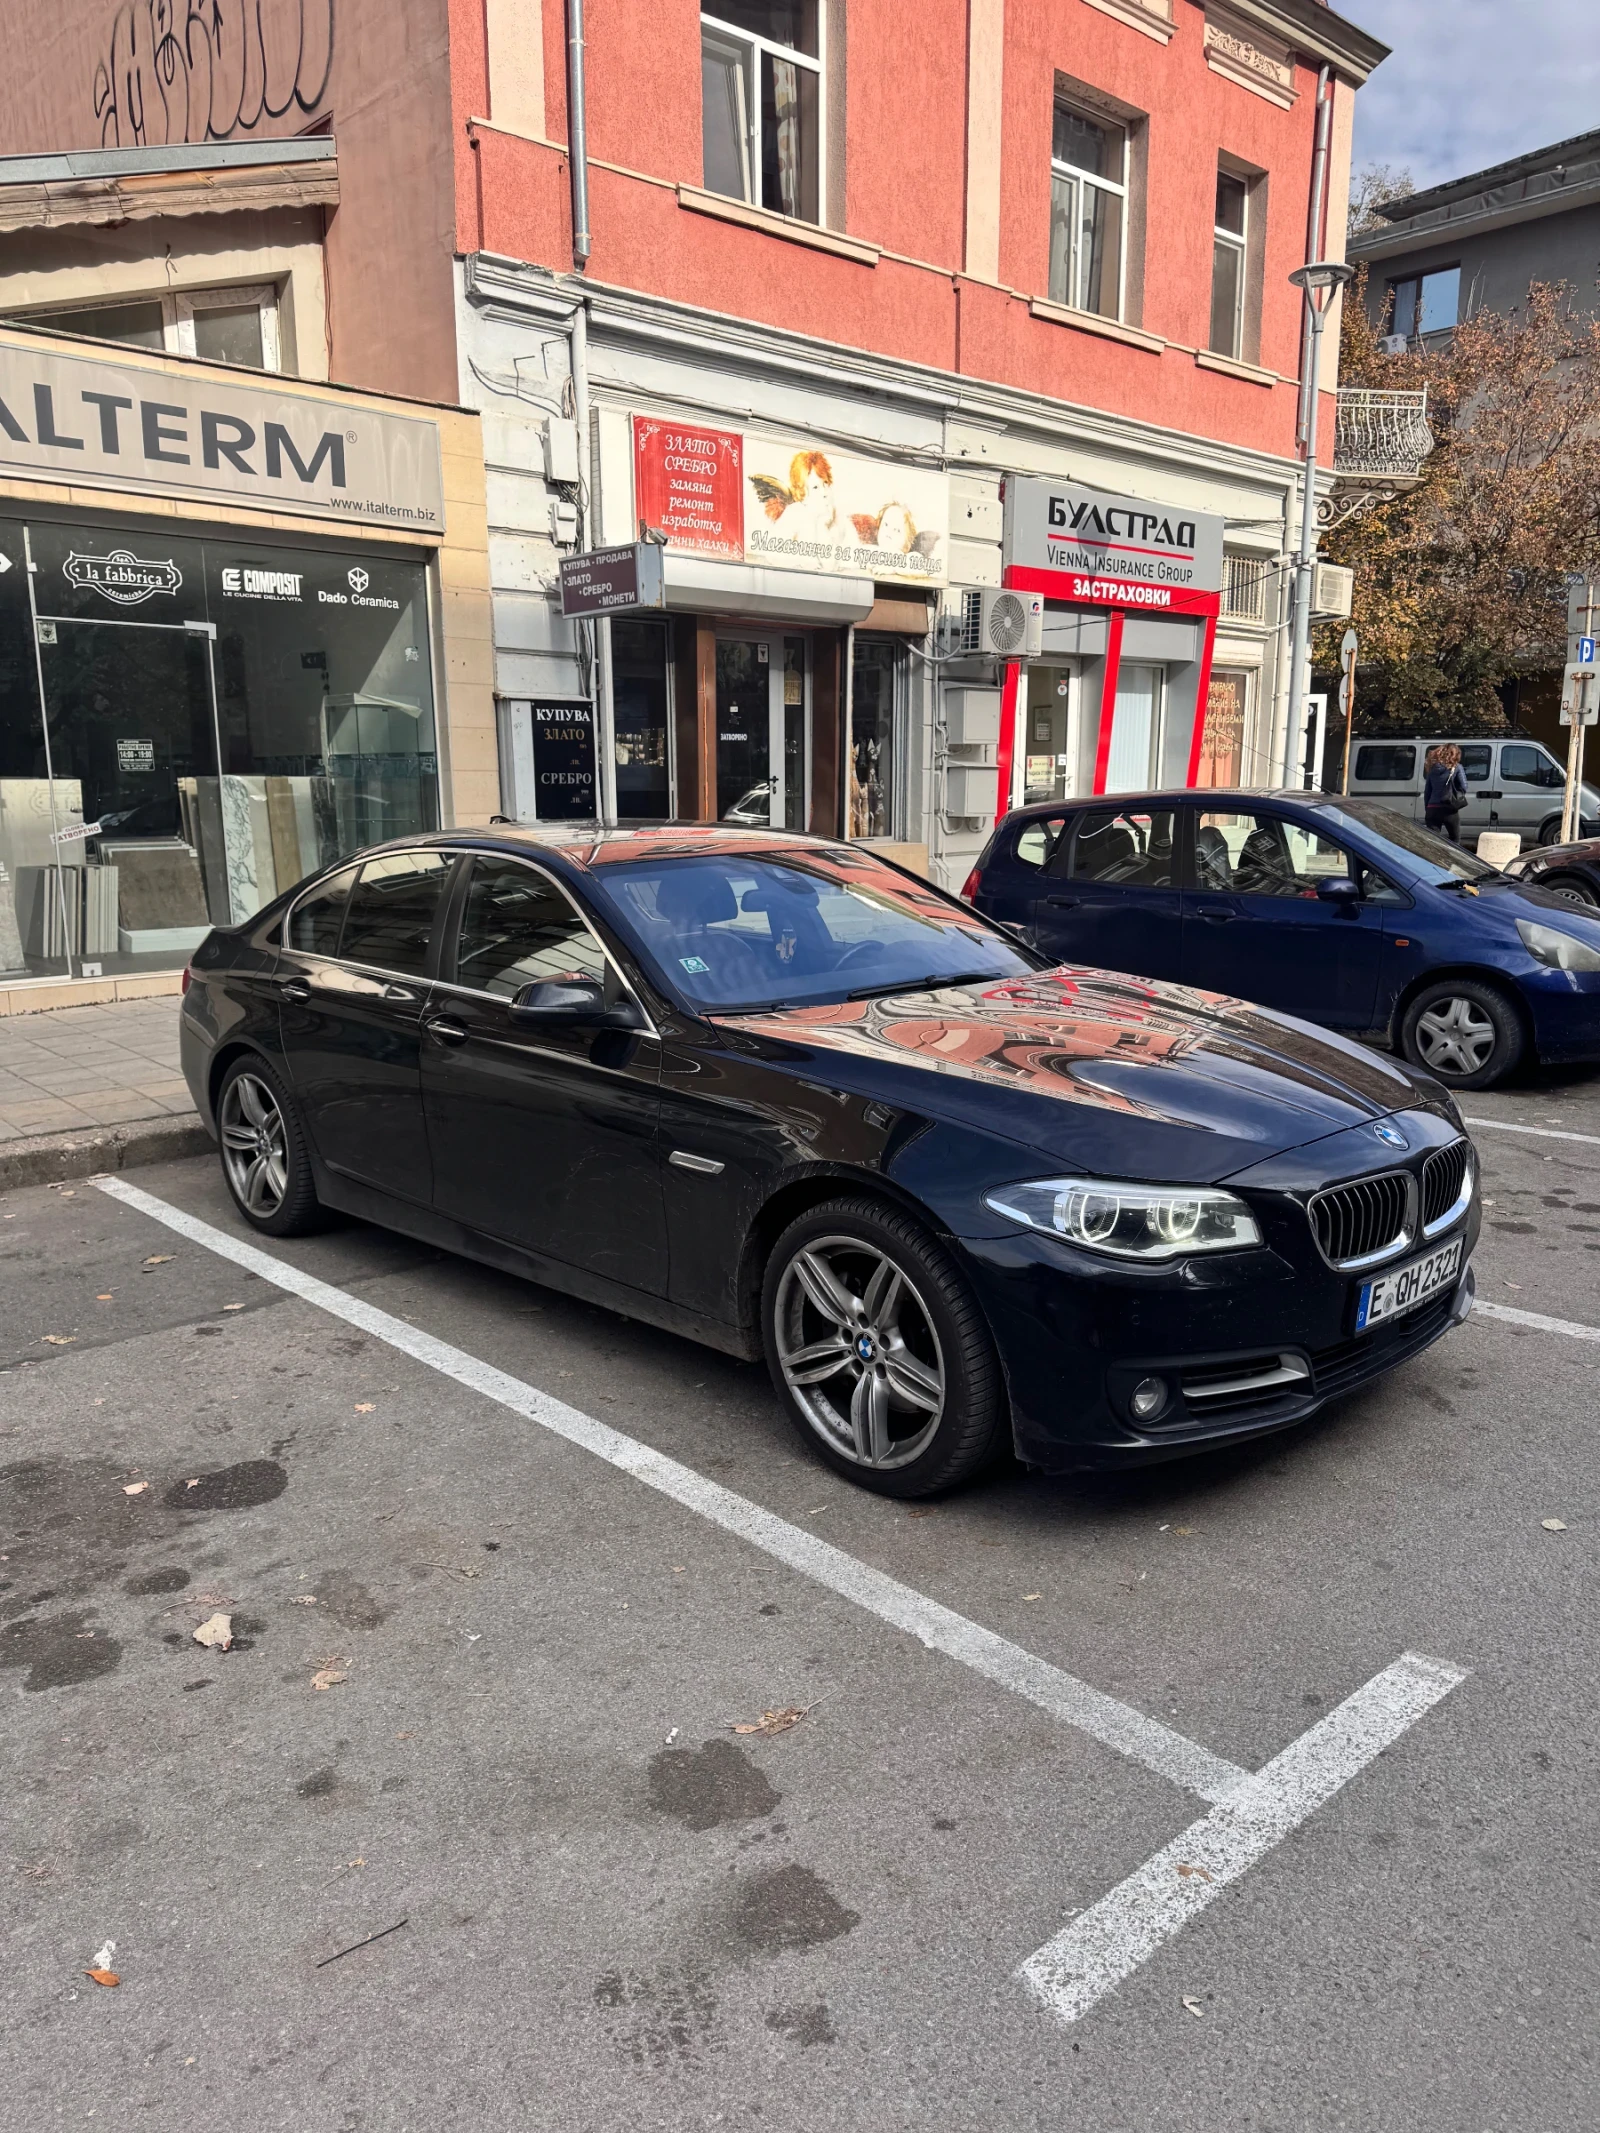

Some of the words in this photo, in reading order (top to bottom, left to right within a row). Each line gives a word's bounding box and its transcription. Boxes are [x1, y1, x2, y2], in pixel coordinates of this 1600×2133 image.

[665, 434, 716, 456] ЗЛАТО
[665, 455, 717, 476] СРЕБРО
[669, 479, 713, 494] замяна
[330, 498, 436, 521] www.italterm.biz
[668, 496, 714, 512] ремонт
[661, 513, 722, 535] изработка
[1048, 496, 1196, 549] БУЛСТРАД
[697, 538, 730, 555] халки
[751, 529, 832, 559] Магазинче
[835, 546, 852, 561] за
[854, 547, 908, 570] красиви
[909, 555, 942, 576] неща
[563, 559, 591, 572] КУПУВА
[596, 550, 633, 565] ПРОДАВА
[1047, 544, 1090, 570] VIENNA
[1094, 552, 1154, 578] INSURANCE
[1157, 561, 1193, 583] GROUP
[86, 563, 99, 580] la
[105, 566, 163, 585] fabbrica
[243, 569, 303, 597] COMPOSIT
[567, 573, 591, 587] ЗЛАТО
[318, 590, 347, 604] Dado
[351, 594, 400, 609] Ceramica
[582, 582, 612, 596] СРЕБРО
[602, 591, 635, 606] МОНЕТИ
[1073, 578, 1172, 606] ЗАСТРАХОВКИ
[1582, 640, 1590, 662] P
[536, 708, 591, 721] КУПУВА
[544, 728, 585, 740] ЗЛАТО
[541, 772, 592, 785] СРЕБРО
[1369, 1281, 1386, 1320] E
